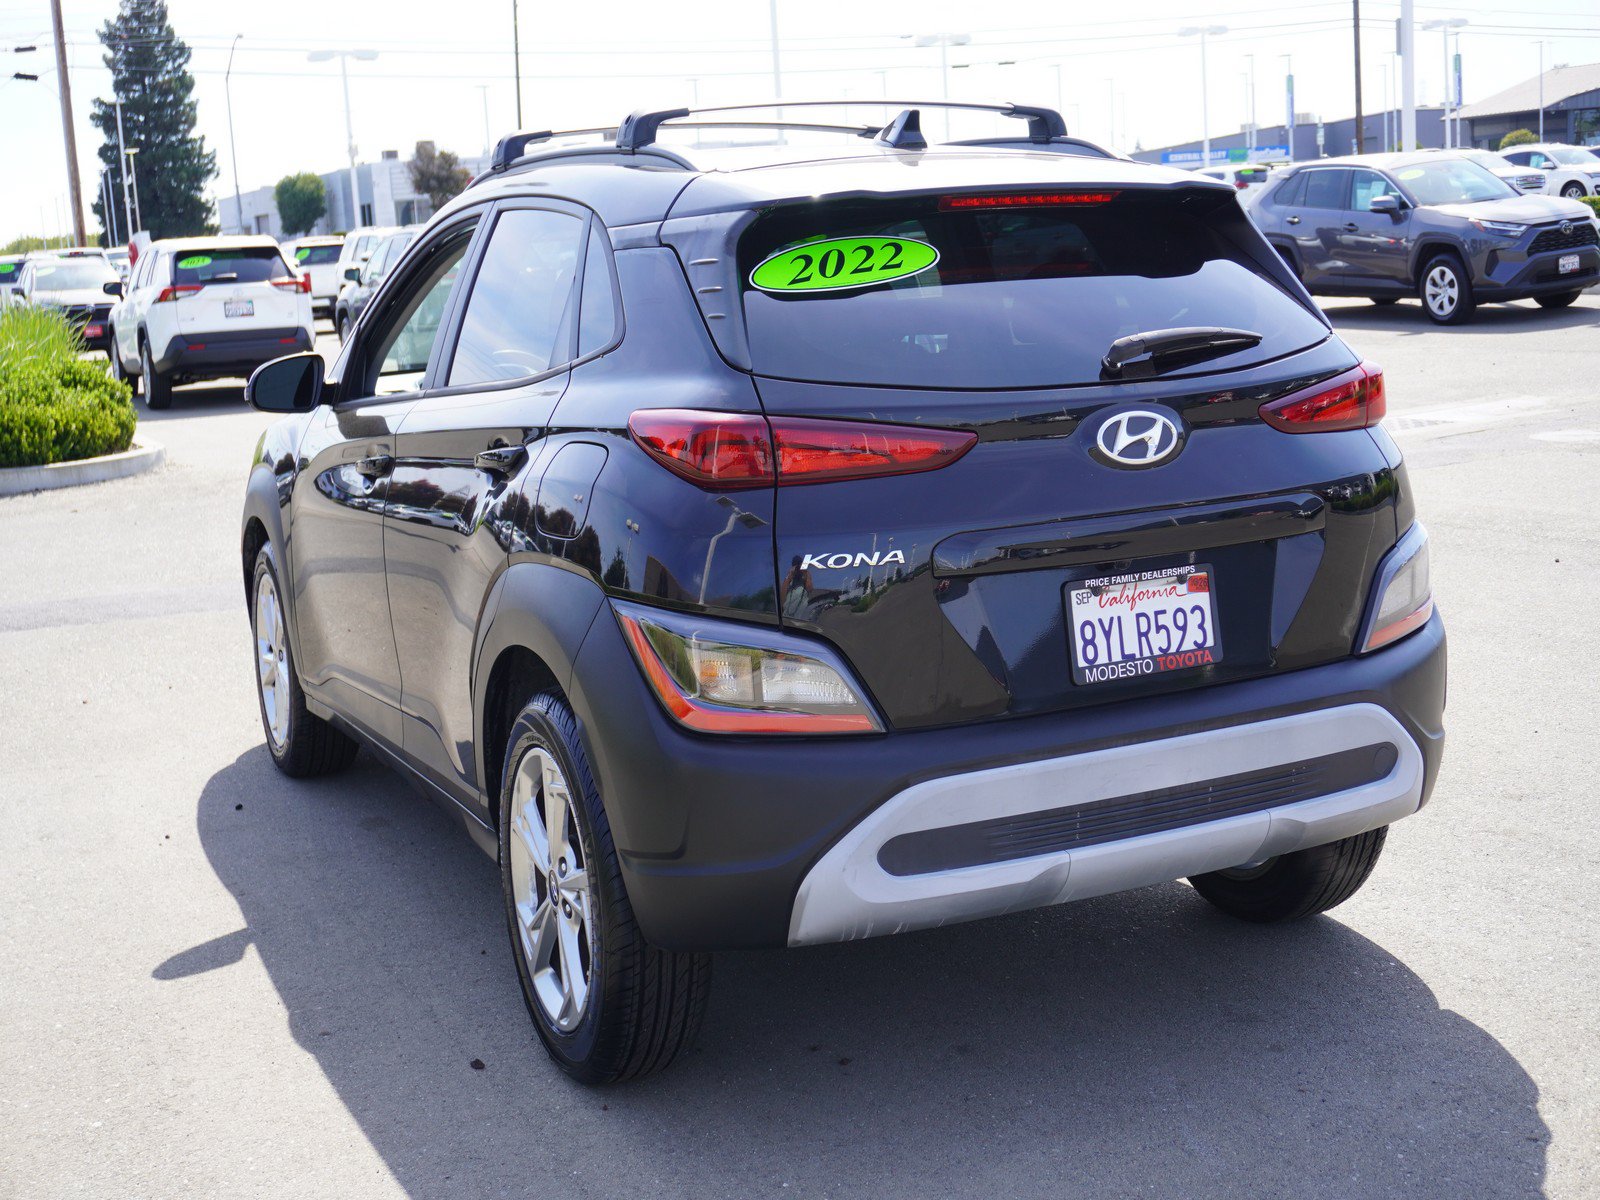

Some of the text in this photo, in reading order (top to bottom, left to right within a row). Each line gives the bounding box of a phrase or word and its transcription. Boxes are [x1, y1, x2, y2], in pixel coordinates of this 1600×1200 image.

[1169, 152, 1200, 162] CENTRAL
[787, 242, 904, 286] 2022
[800, 550, 906, 570] KONA
[1085, 565, 1196, 588] PRICE FAMILY DEALERSHIPS
[1075, 584, 1187, 612] SEP California
[1080, 604, 1208, 665] 8YLR593
[1085, 650, 1213, 683] MODESTO TOYOTA
